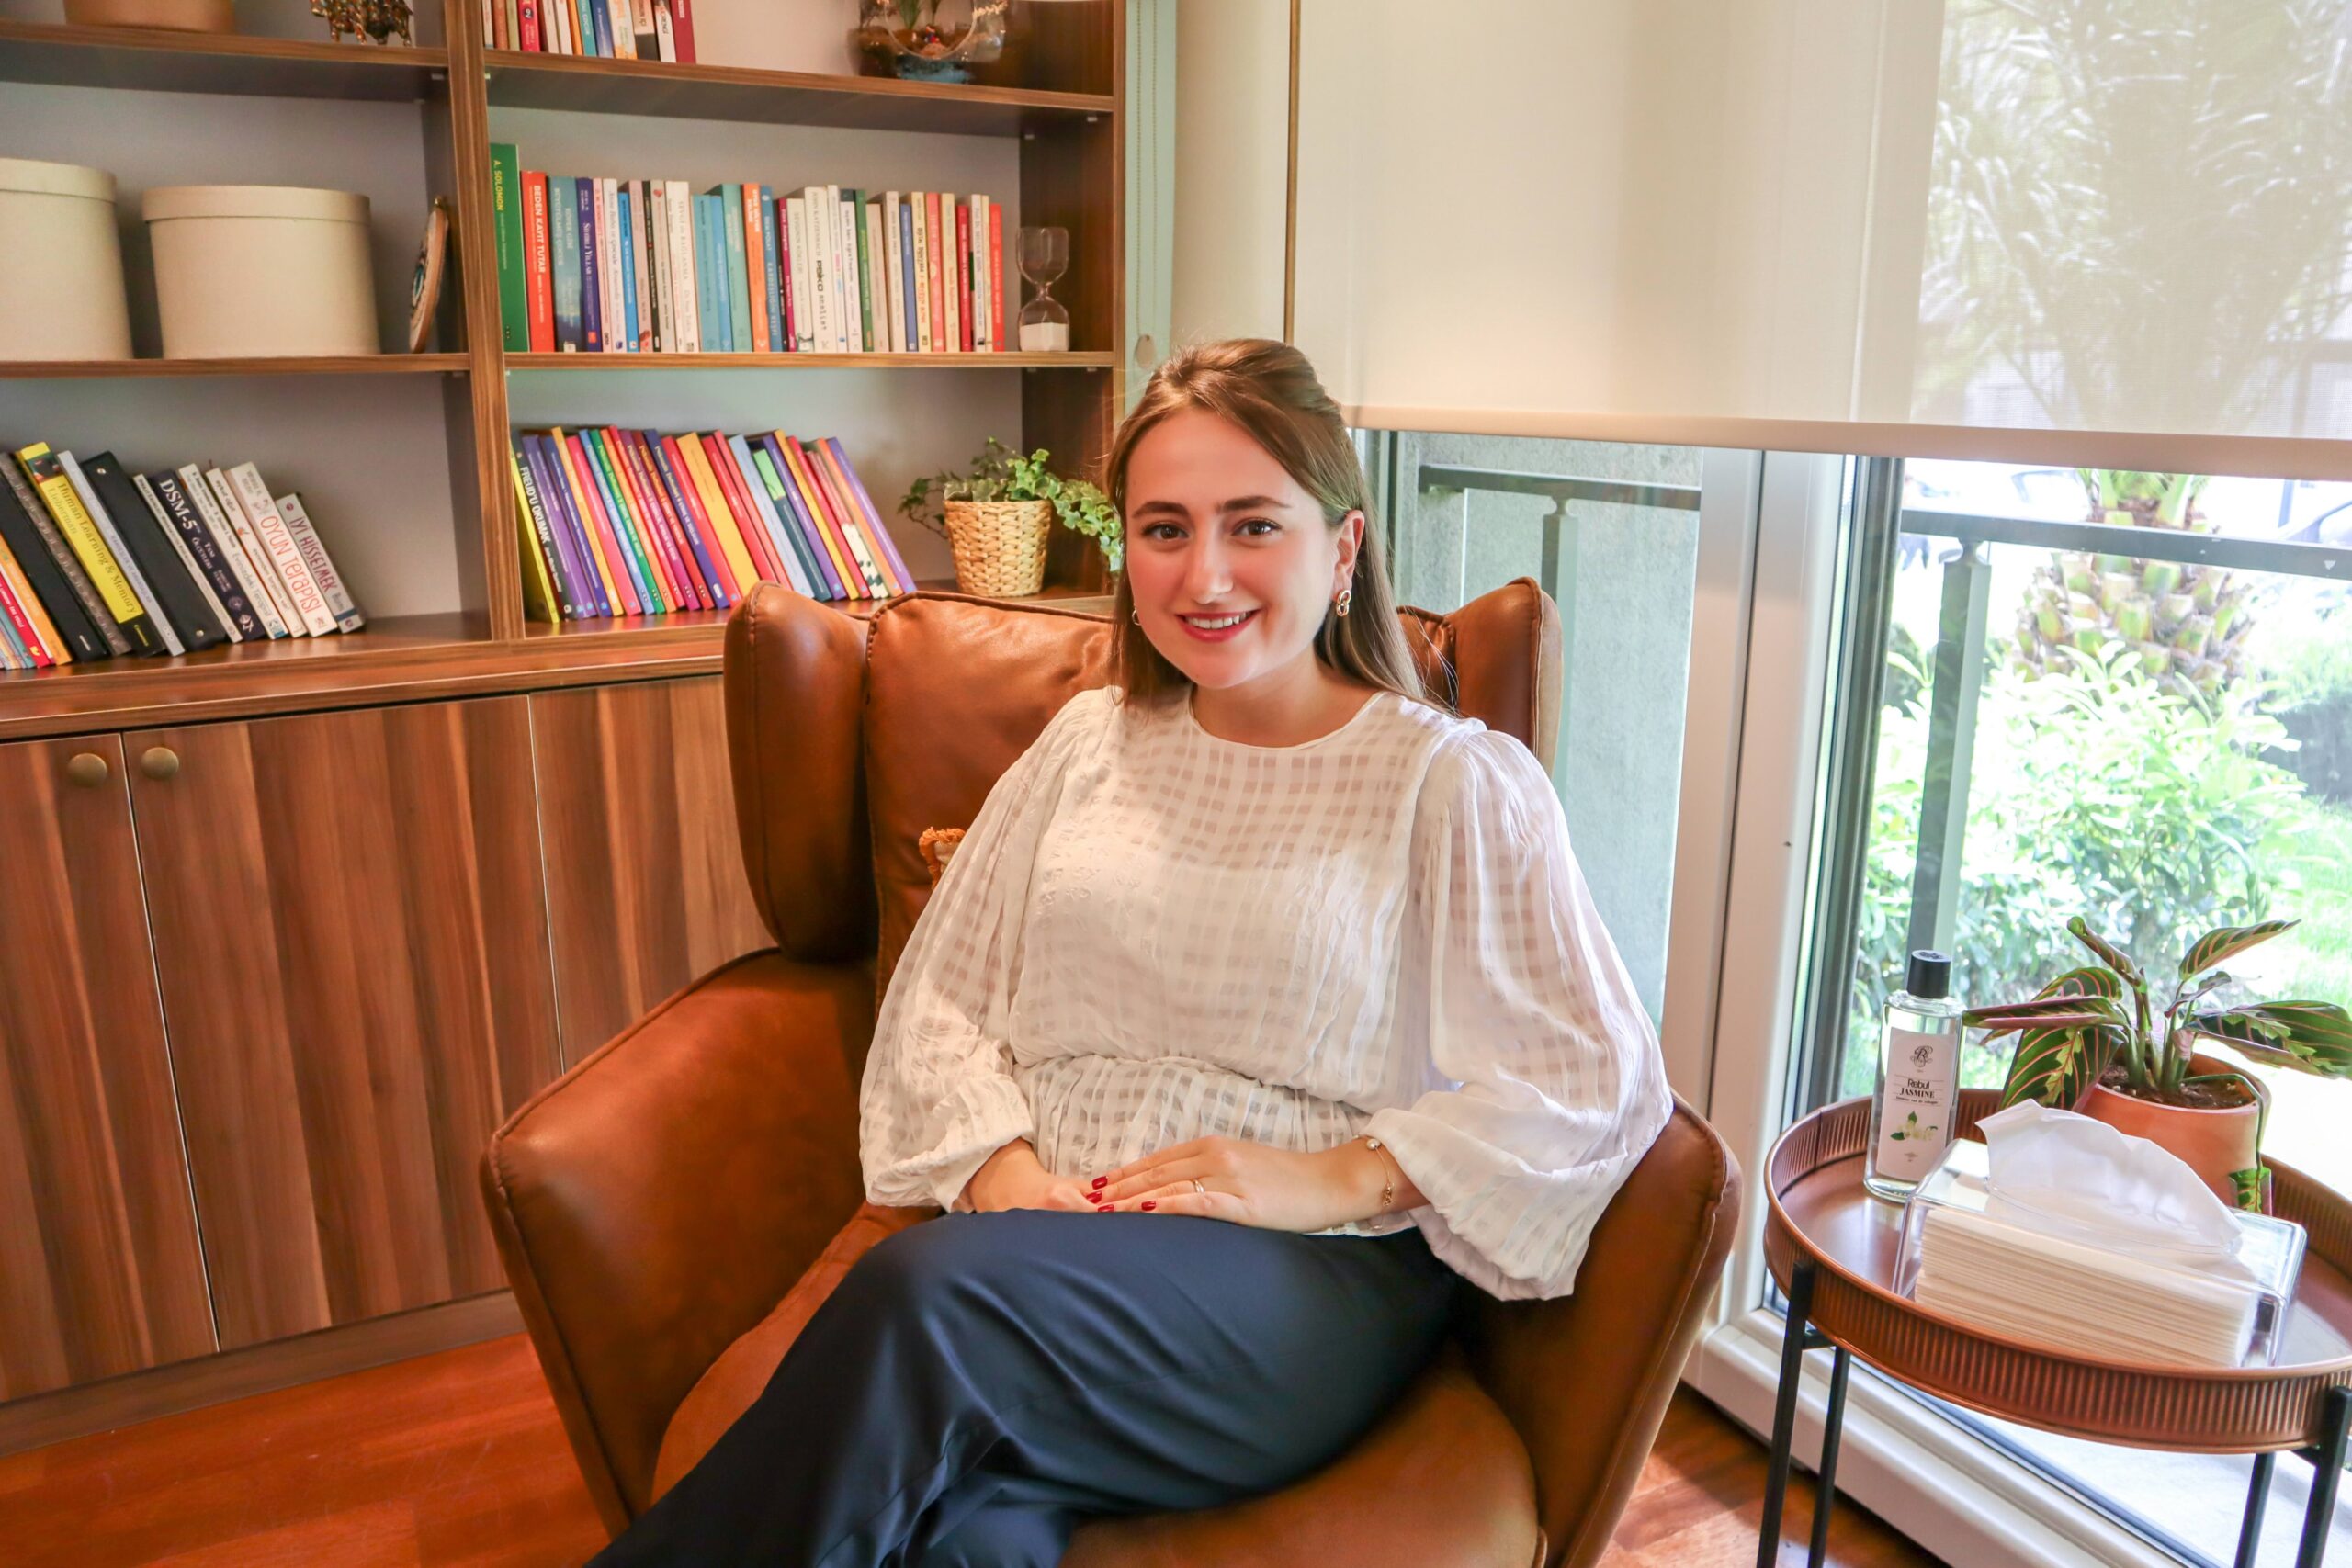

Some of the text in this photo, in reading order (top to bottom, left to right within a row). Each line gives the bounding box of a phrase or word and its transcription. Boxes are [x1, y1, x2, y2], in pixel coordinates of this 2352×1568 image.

[494, 171, 504, 211] SOLOMON
[534, 186, 542, 216] BEDEN
[536, 218, 544, 243] KAYIT
[537, 245, 546, 274] TUTAR
[520, 467, 537, 502] FREUD'U
[531, 506, 551, 543] OKUMAK
[58, 483, 82, 519] Human
[80, 521, 110, 565] Learning
[111, 575, 136, 614] Memory
[260, 515, 293, 556] OYUN
[290, 517, 307, 533] İYİ
[299, 537, 337, 592] HİSSETMEK
[1900, 1088, 1935, 1099] JASMINE
[1907, 1078, 1930, 1089] Rebul
